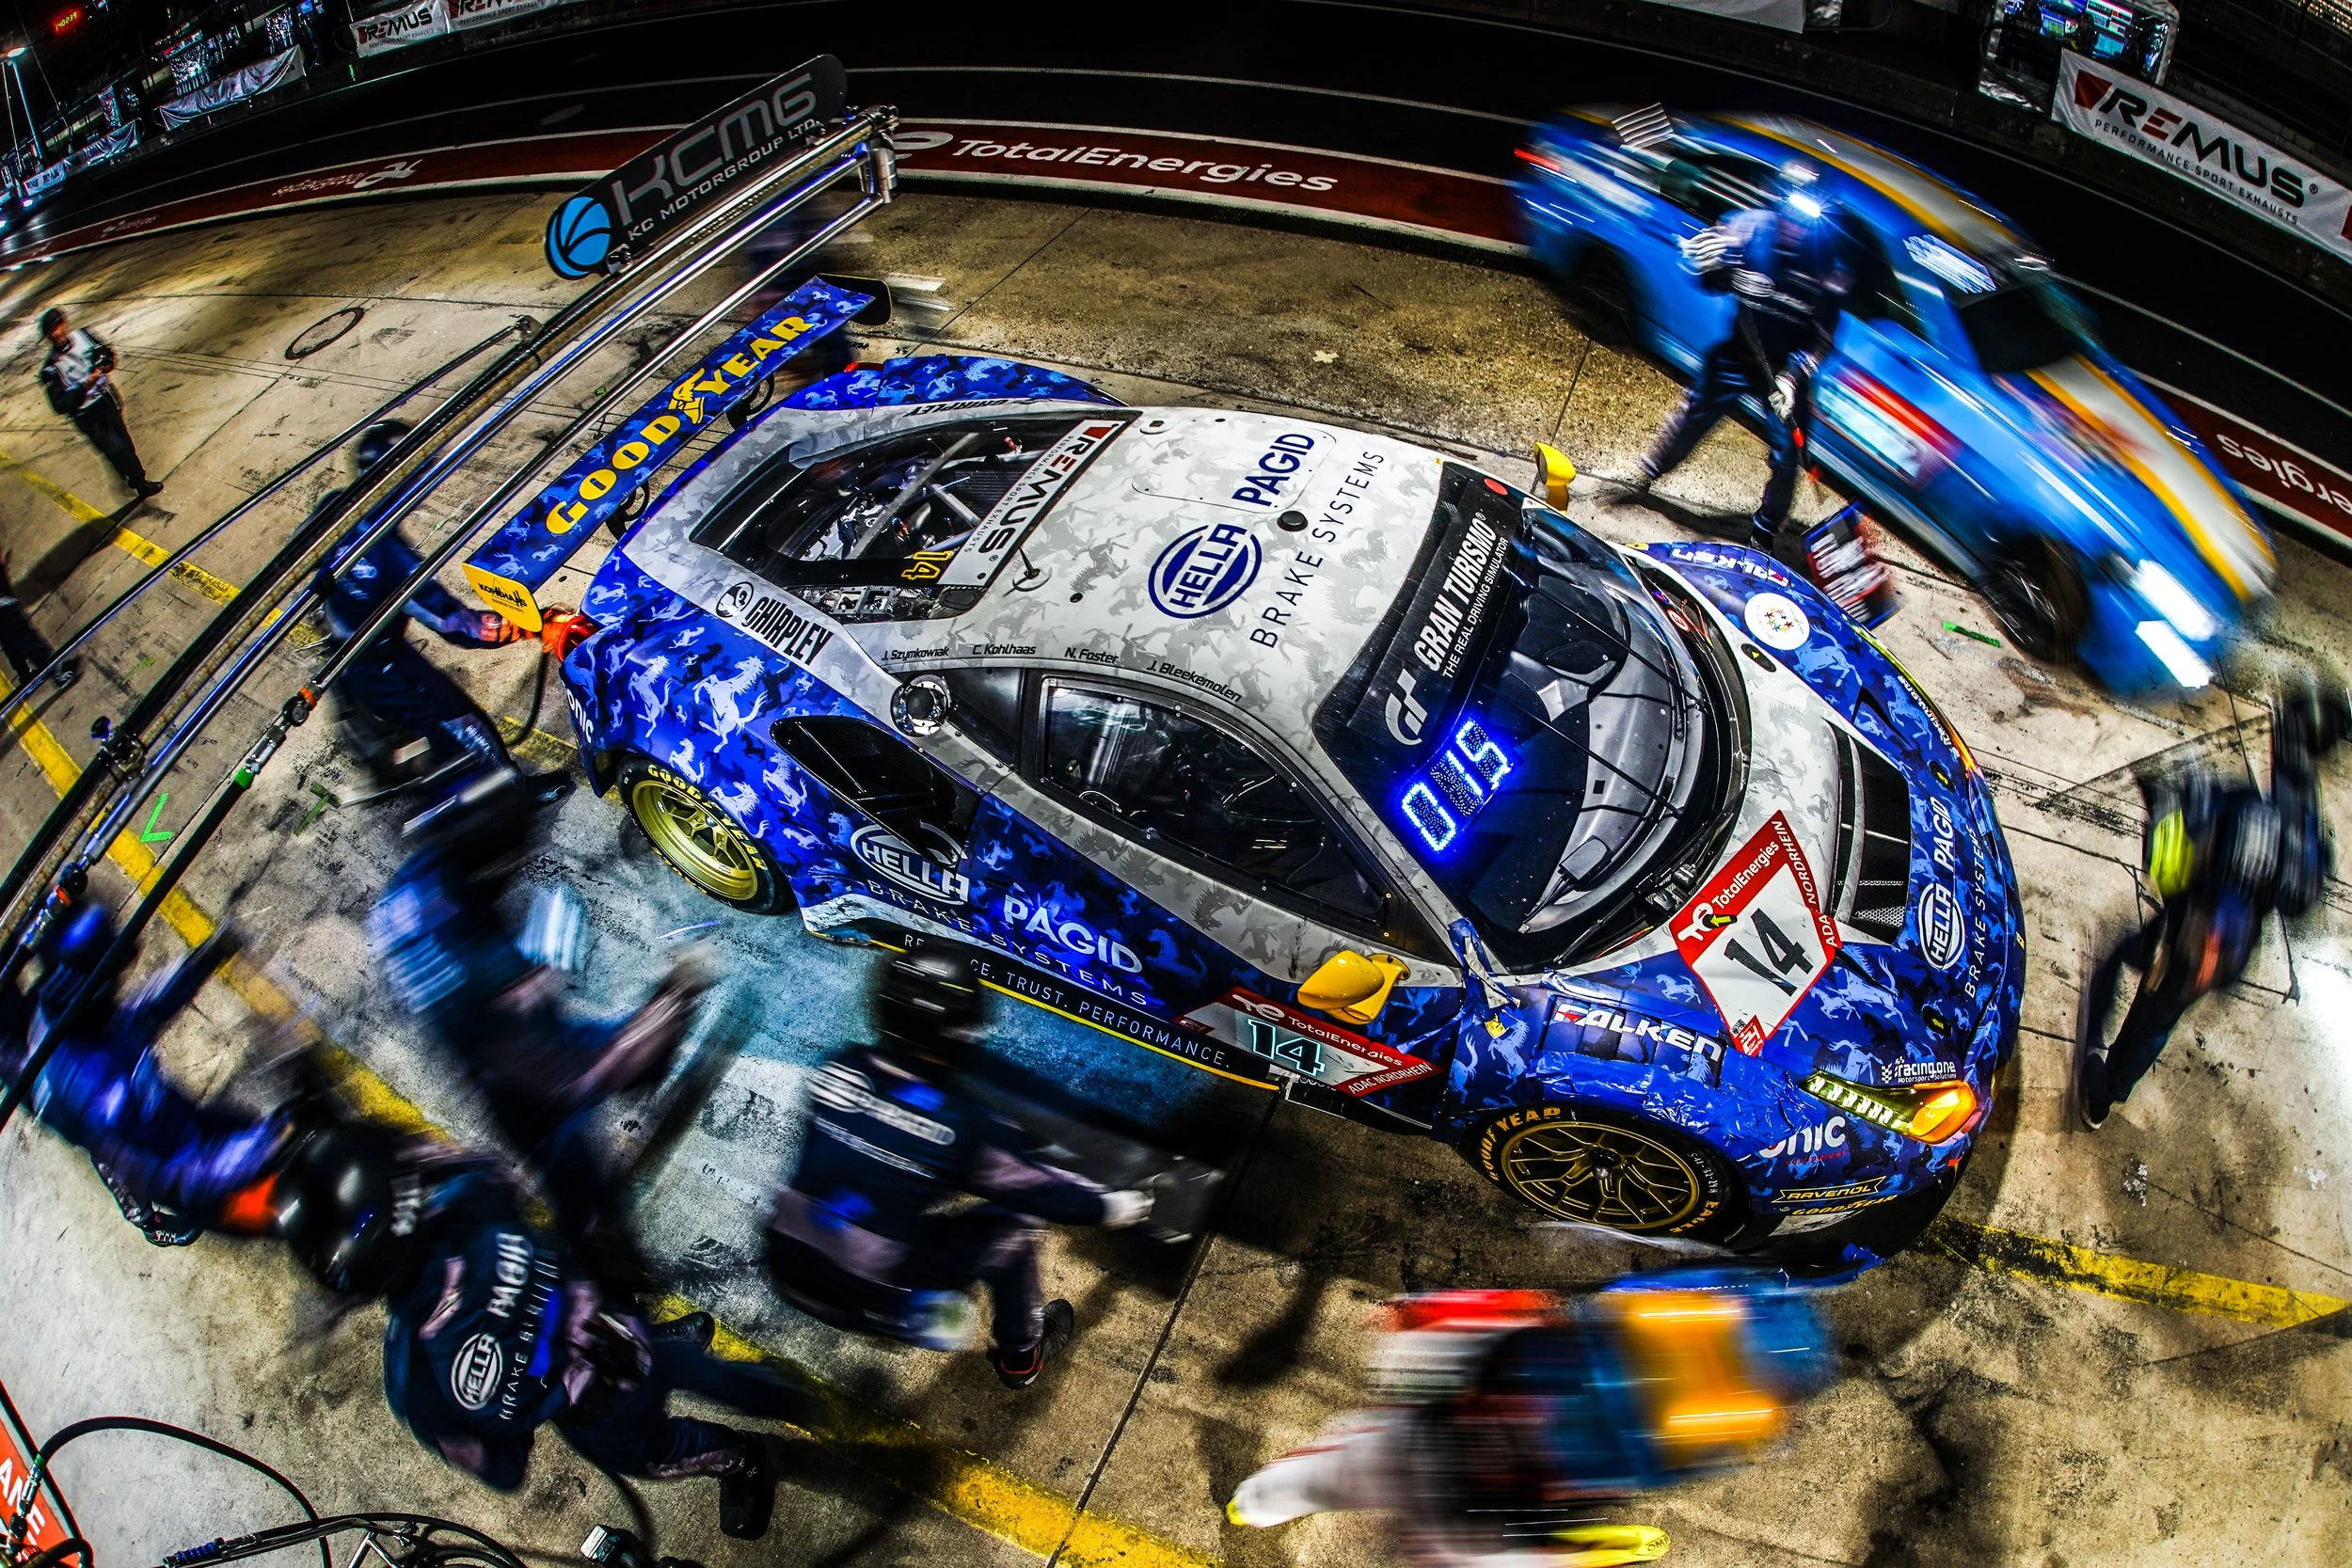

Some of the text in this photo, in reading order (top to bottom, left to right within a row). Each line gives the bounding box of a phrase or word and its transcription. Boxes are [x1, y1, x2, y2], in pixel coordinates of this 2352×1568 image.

[366, 8, 433, 40] REMUS
[612, 73, 817, 227] KCMG
[952, 140, 1338, 191] TotalEnergies
[2094, 119, 2298, 225] PERFORMANCE SPORT EXHAUSTS
[2099, 87, 2305, 208] REMUS
[628, 217, 655, 241] KC
[660, 137, 784, 219] MOTORGROUP
[978, 436, 1097, 554] REMUS
[1002, 482, 1028, 506] SPORT
[1232, 434, 1315, 507] PAGID
[901, 550, 953, 579] 14
[1169, 523, 1247, 608] HELLA
[1249, 451, 1386, 649] BRAKE SYSTEMS
[1414, 517, 1496, 672] GRAN TURISMO
[1442, 536, 1509, 678] THE REAL DRIVING SIMULATOR
[881, 645, 950, 662] J. Szymkowiak
[971, 643, 1037, 657] C. Kohlhaas
[1064, 647, 1120, 665] N. Foster
[1145, 660, 1243, 703] J. Bleekemolen
[1401, 720, 1512, 852] 015
[861, 841, 970, 902] HELLA
[1772, 820, 1817, 905] NORDRHEIN
[1930, 796, 1954, 872] PAGID
[1711, 841, 1780, 910] TotalEnergies
[1964, 824, 1986, 999] BRAKE SYSTEMS
[867, 879, 1149, 1006] BRAKE SYSTEMS
[1003, 893, 1143, 974] PAGID
[1724, 908, 1814, 997] 14
[1930, 883, 1952, 961] HELLA
[1006, 972, 1069, 1008] TRUST.
[1079, 1001, 1230, 1069] PERFORMANCE.
[1248, 1019, 1326, 1076] 14
[1289, 1017, 1402, 1067] TotalEnergies
[1347, 1078, 1375, 1095] ADAC
[1376, 1062, 1433, 1085] NORDRHEIN
[1785, 1150, 1846, 1165] equipment
[1788, 1184, 1871, 1200] RAVENOL
[465, 1331, 497, 1406] HELLA
[499, 1351, 530, 1420] BRAKE
